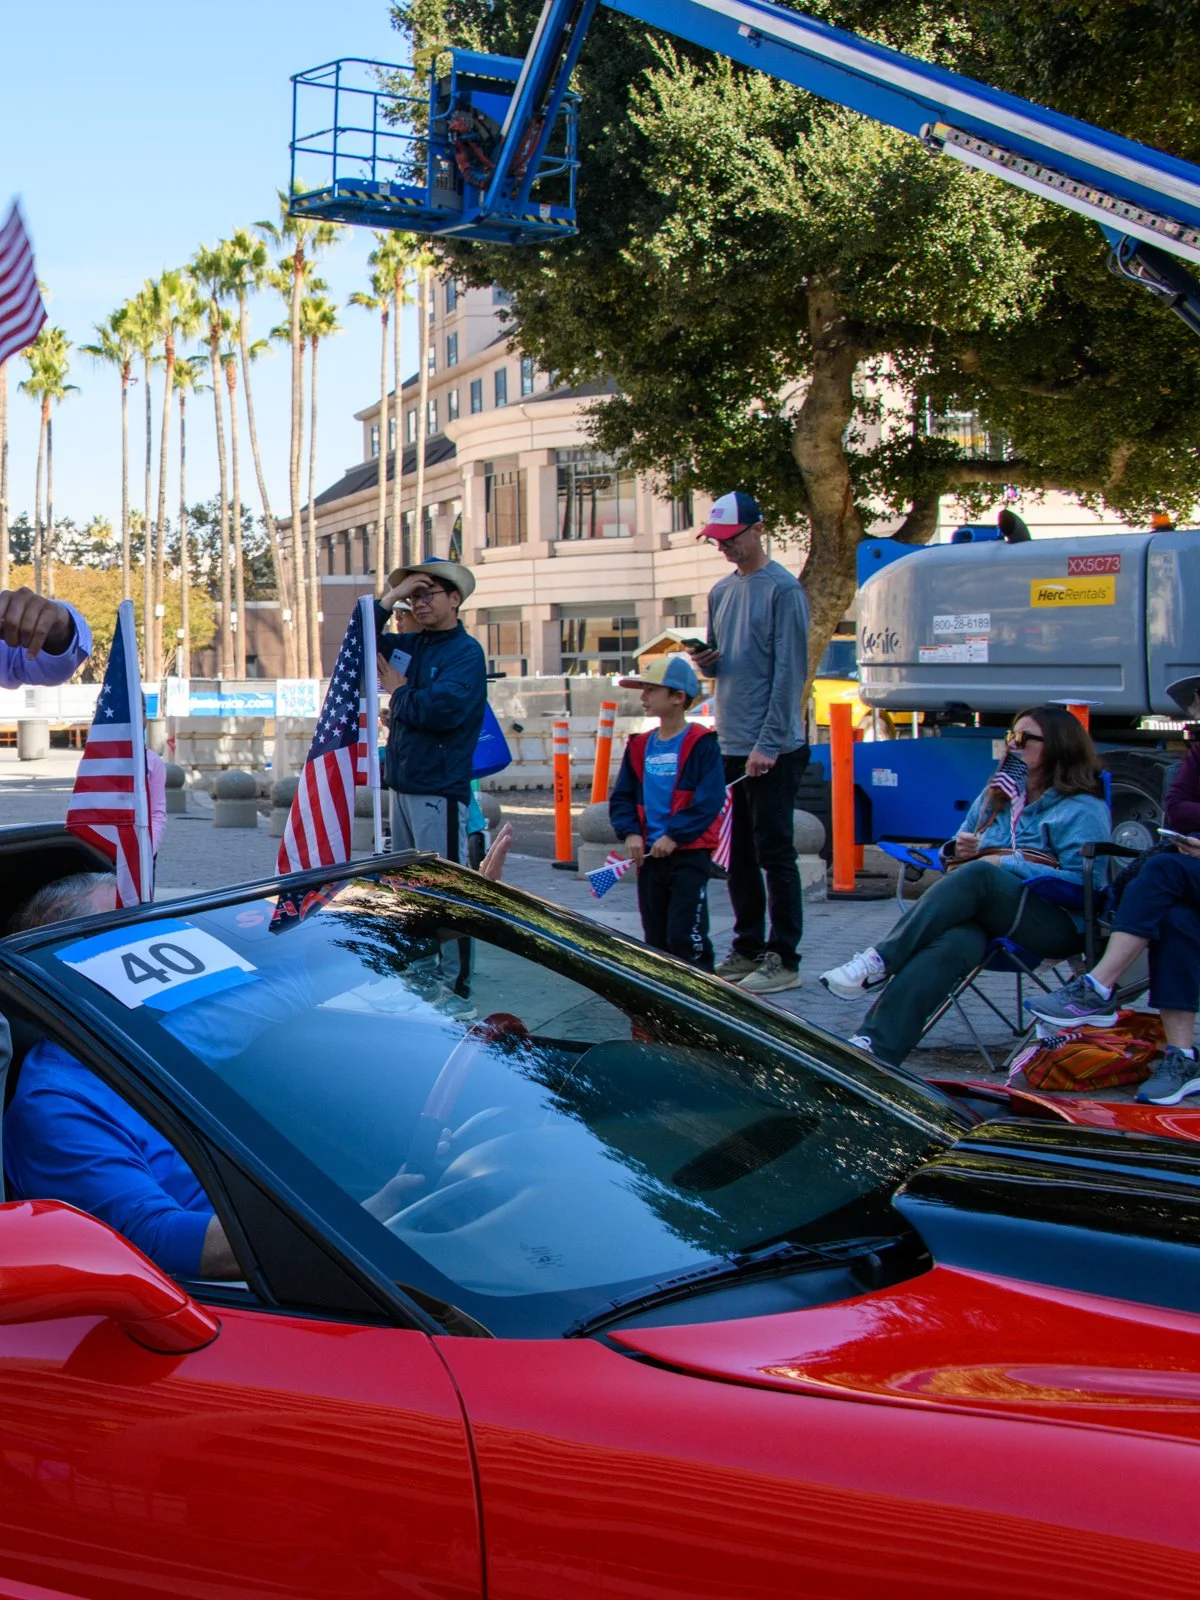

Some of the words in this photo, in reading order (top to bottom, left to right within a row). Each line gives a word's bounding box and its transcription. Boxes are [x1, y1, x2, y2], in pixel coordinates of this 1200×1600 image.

[1068, 556, 1120, 573] XX5C73
[934, 617, 990, 631] 800-28-6189
[120, 942, 206, 985] 40
